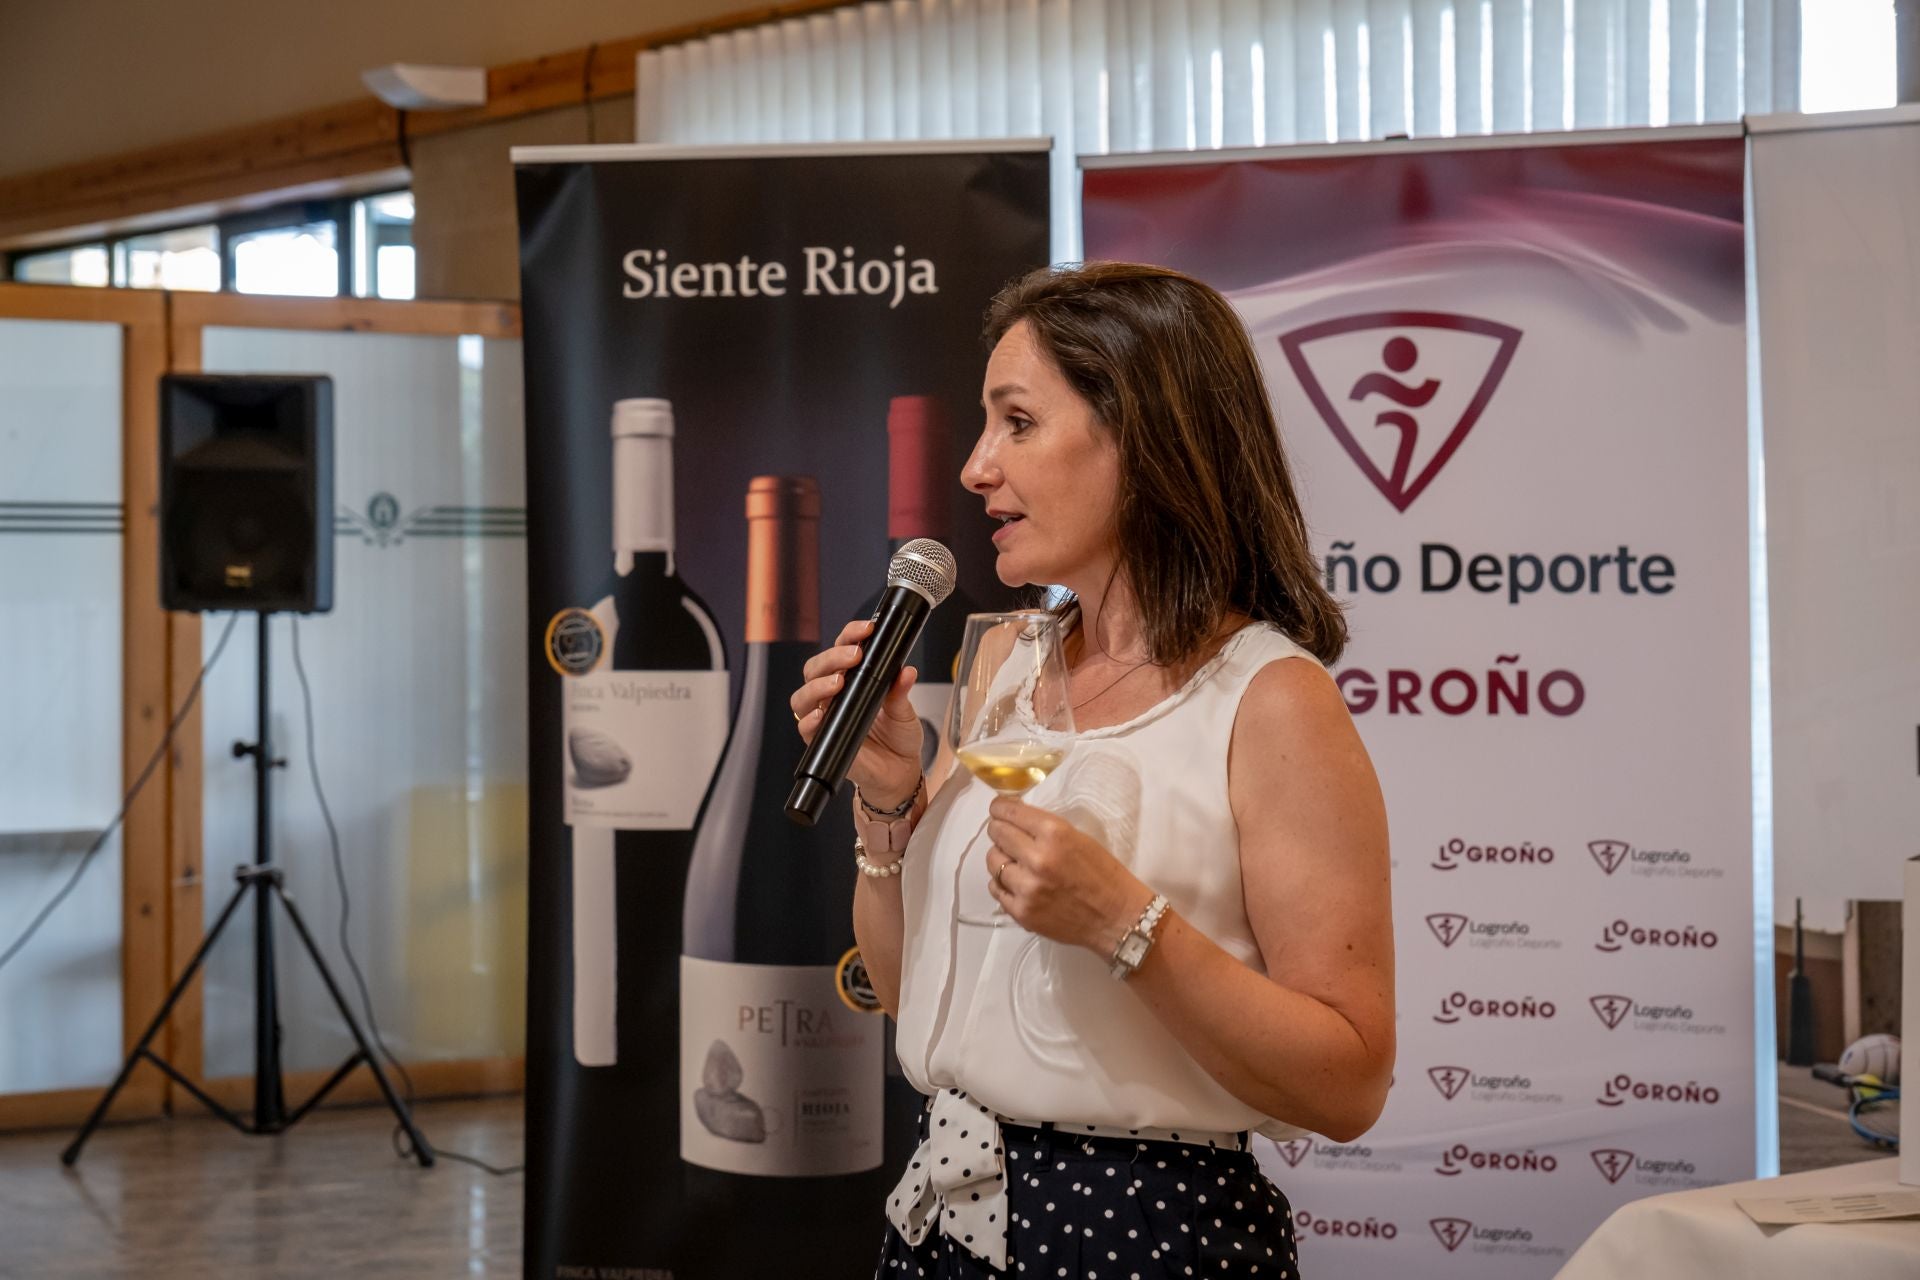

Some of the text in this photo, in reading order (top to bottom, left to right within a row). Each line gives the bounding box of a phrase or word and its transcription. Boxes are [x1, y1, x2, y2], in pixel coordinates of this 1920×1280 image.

[622, 245, 940, 309] Siente Rioja
[1420, 542, 1676, 604] Deporte
[1335, 654, 1586, 717] GROÑO
[1440, 838, 1554, 864] LOGROÑO
[1631, 848, 1691, 864] Logroño
[1469, 921, 1530, 936] Logroño
[1604, 919, 1718, 948] LOGROÑO
[1442, 991, 1556, 1018] LOGROÑO
[1633, 1003, 1693, 1020] Logroño
[738, 998, 834, 1048] PETRA
[1471, 1074, 1532, 1090] Logroño
[1605, 1074, 1720, 1104] LOGROÑO
[1314, 1142, 1372, 1158] Logroño
[1443, 1143, 1557, 1172] LOGROÑO
[1635, 1158, 1696, 1174] Logroño
[1294, 1210, 1397, 1240] OGROÑO
[1473, 1225, 1533, 1242] Logroño
